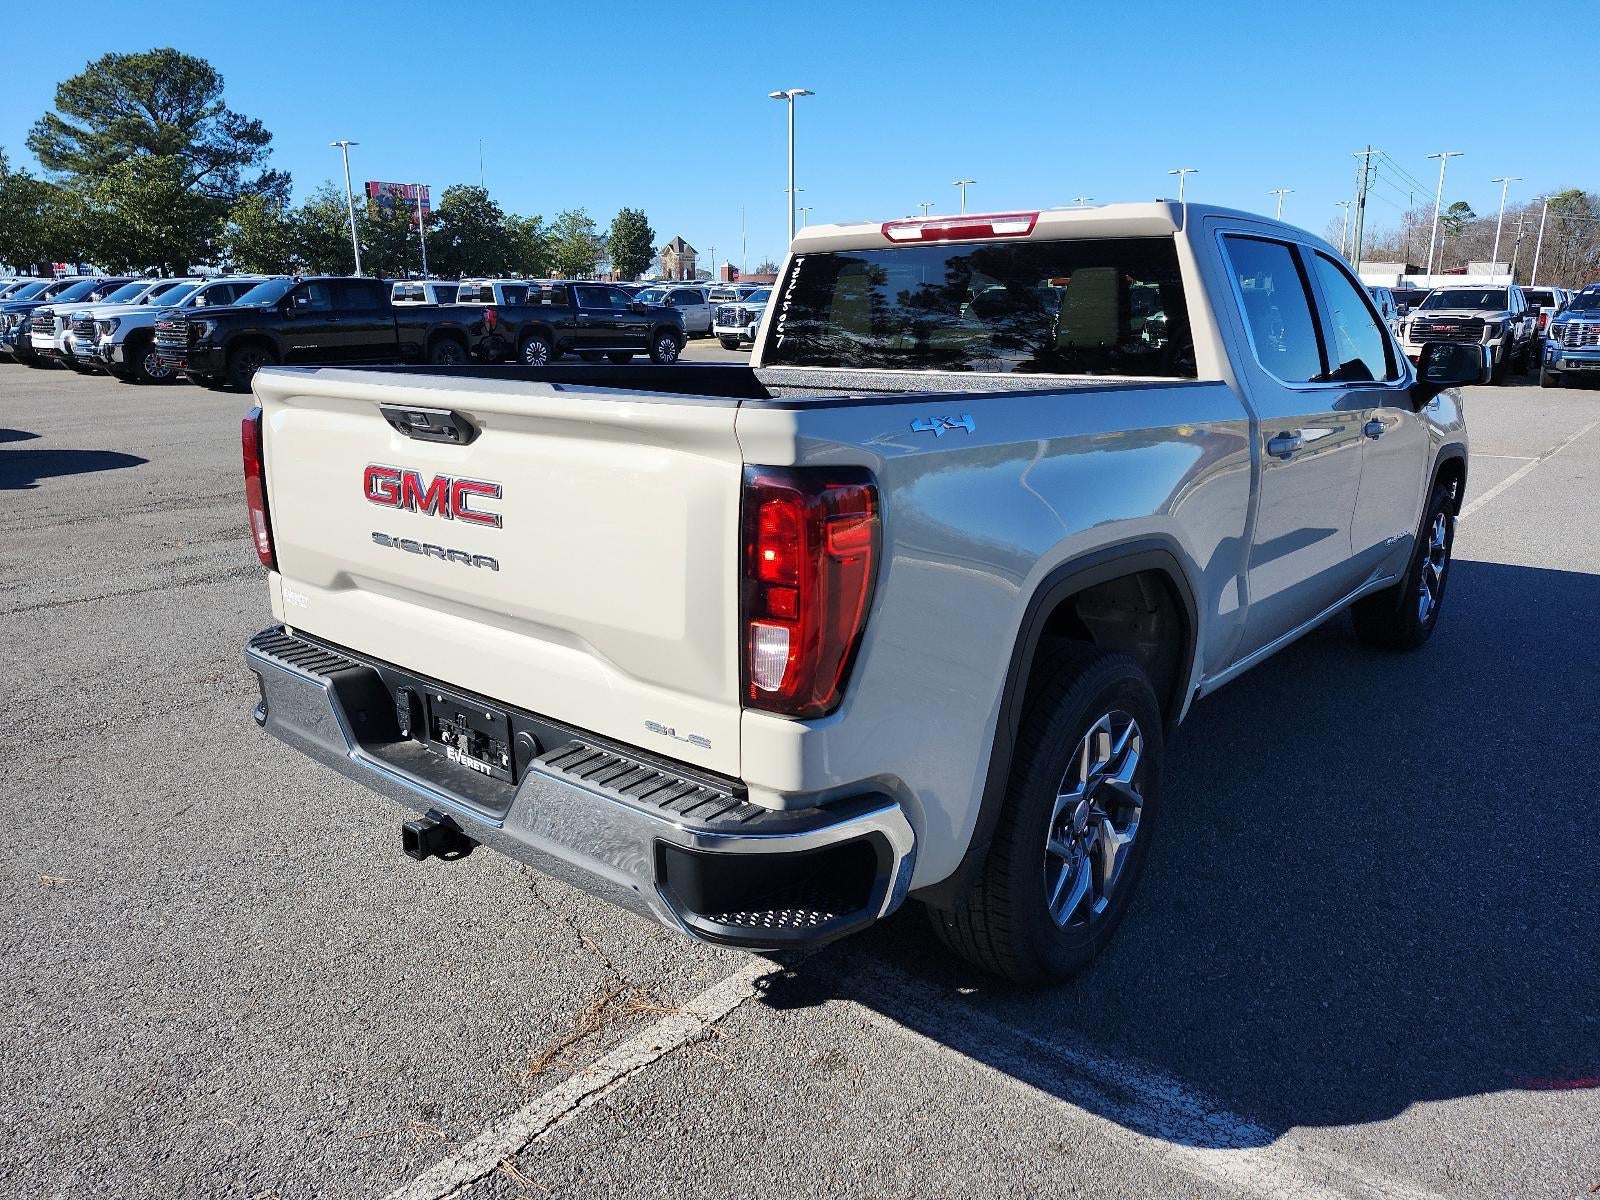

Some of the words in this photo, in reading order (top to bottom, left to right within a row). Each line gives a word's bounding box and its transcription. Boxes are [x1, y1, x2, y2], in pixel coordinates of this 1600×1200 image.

[364, 462, 503, 529] GMC
[371, 531, 500, 572] SIERRA
[644, 720, 712, 749] SLE
[446, 746, 492, 776] EVERETT
